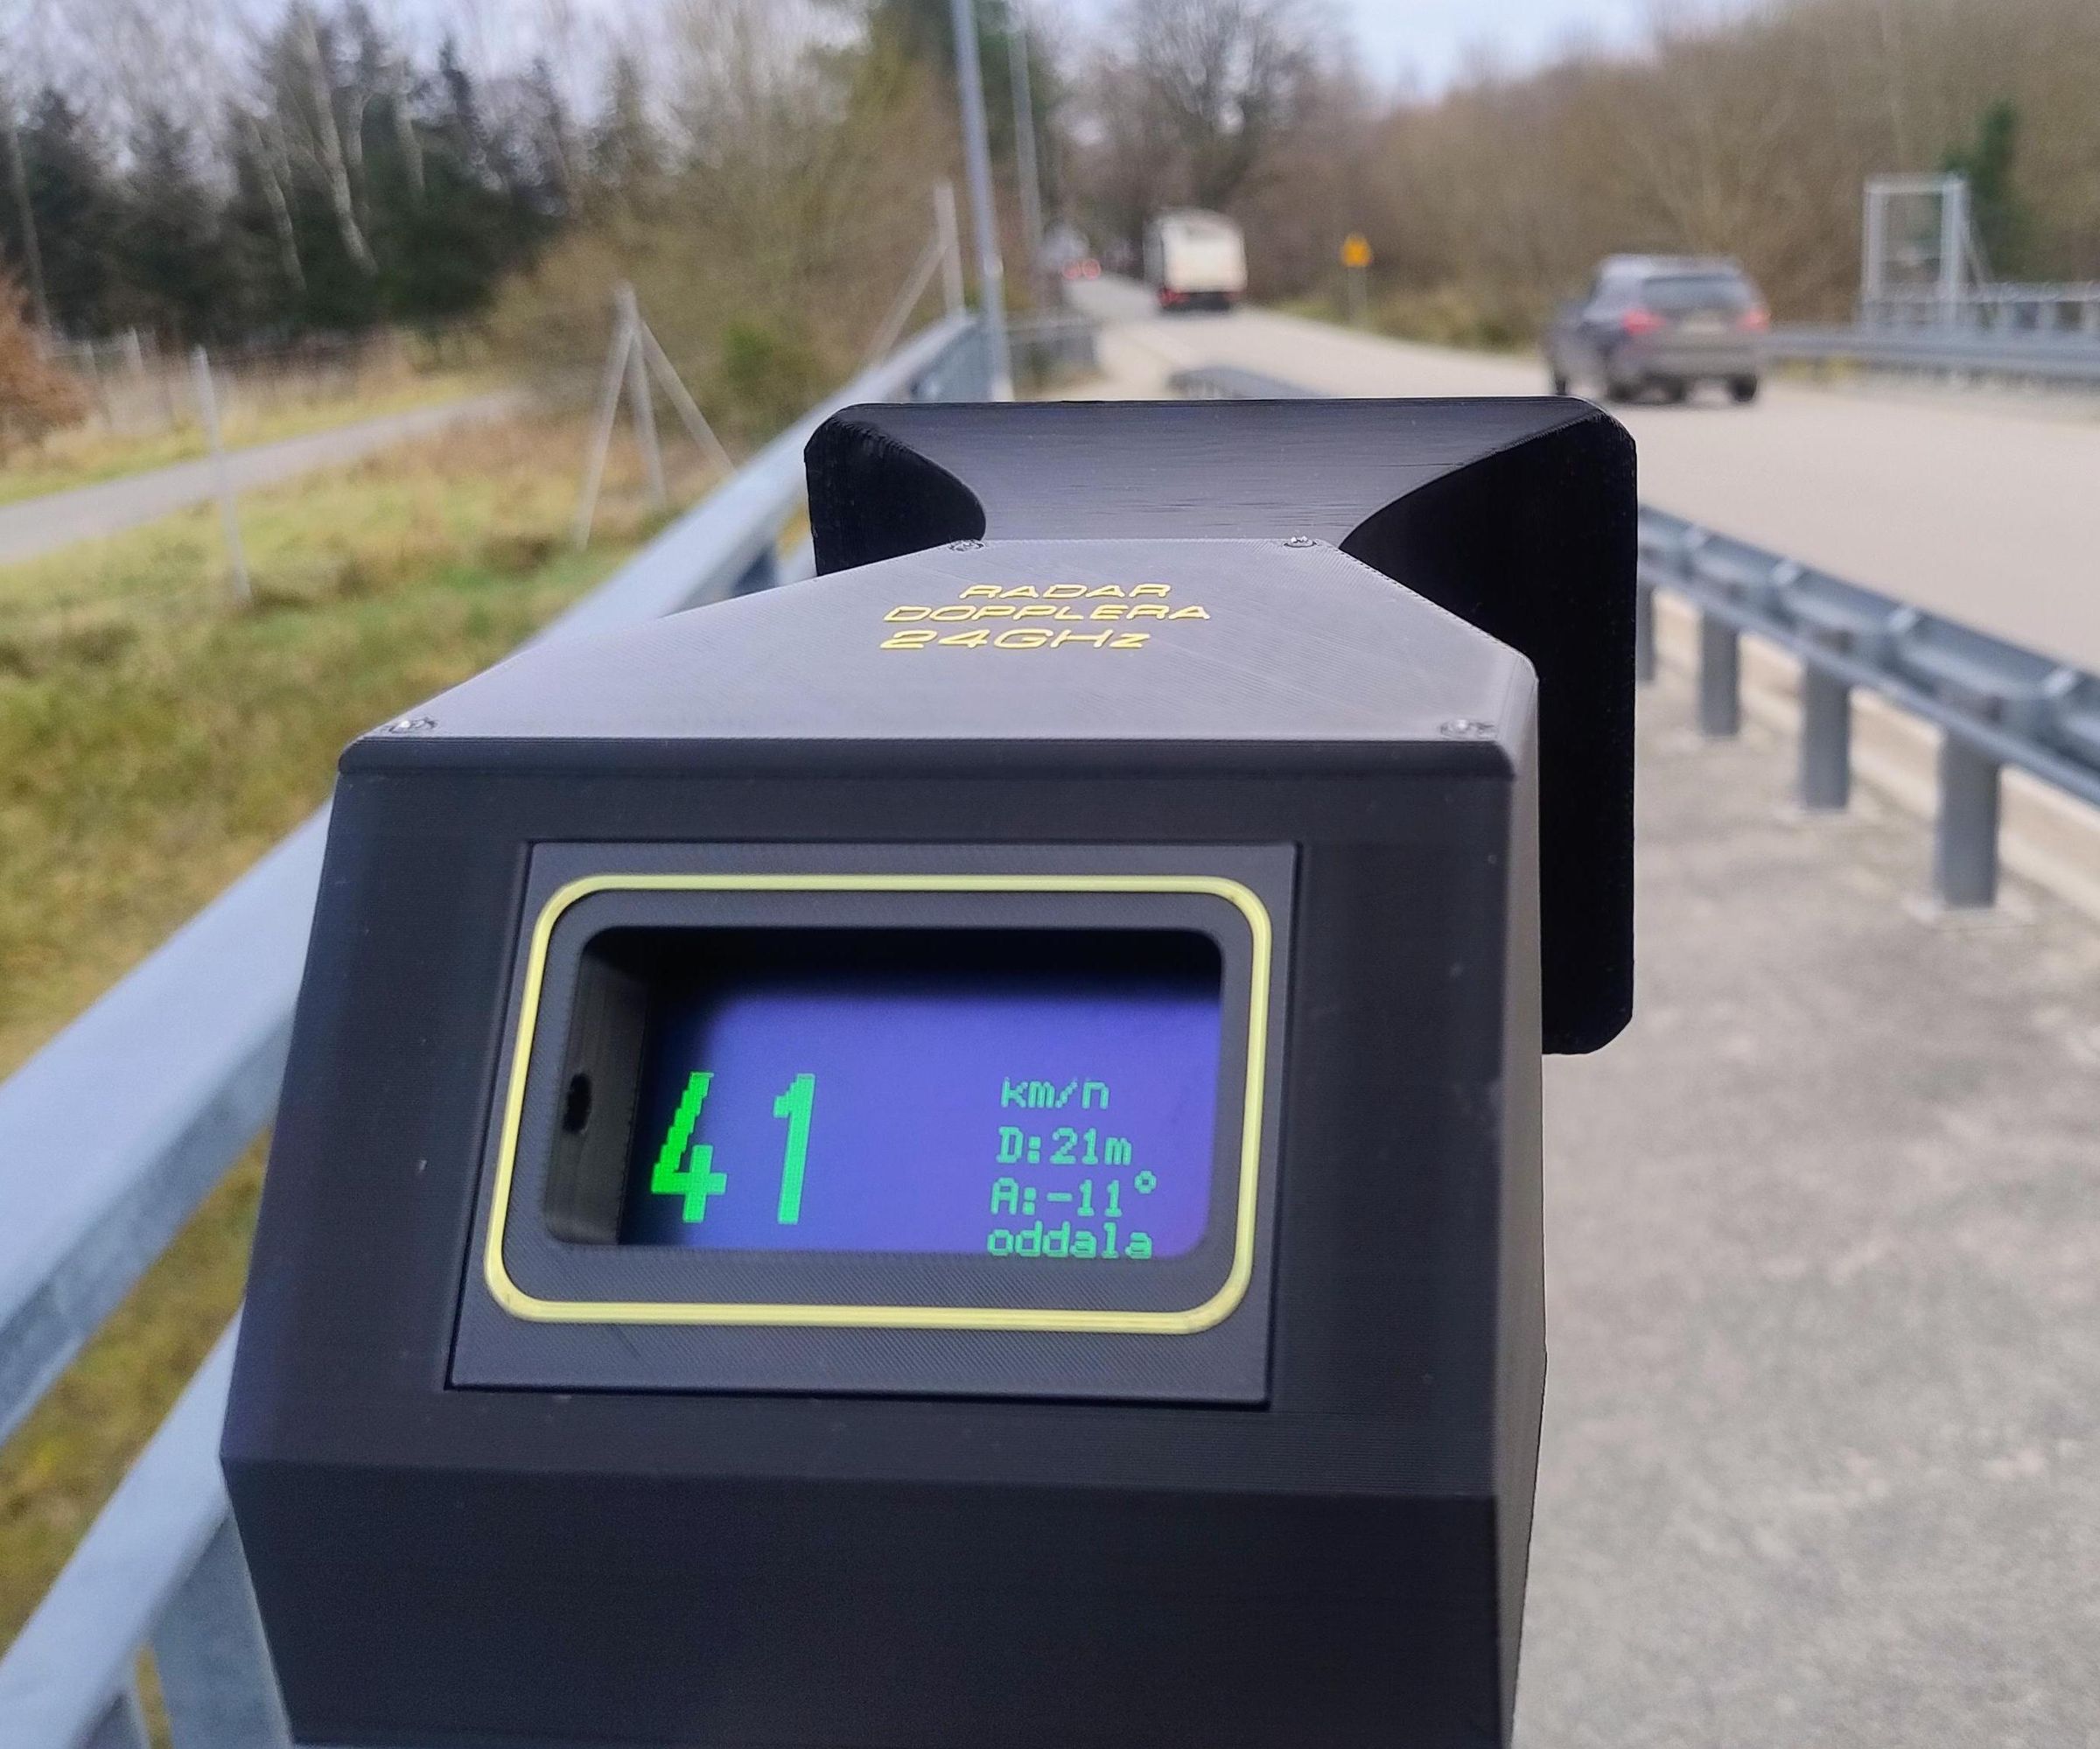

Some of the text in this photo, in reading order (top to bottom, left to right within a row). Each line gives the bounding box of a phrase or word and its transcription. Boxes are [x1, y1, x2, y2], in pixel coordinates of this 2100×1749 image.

[959, 584, 1171, 599] RADAR
[884, 605, 1211, 622] DOPPLERA
[880, 628, 1152, 649] 24GHz
[996, 1126, 1132, 1165] D:21m
[987, 1221, 1152, 1259] oddala
